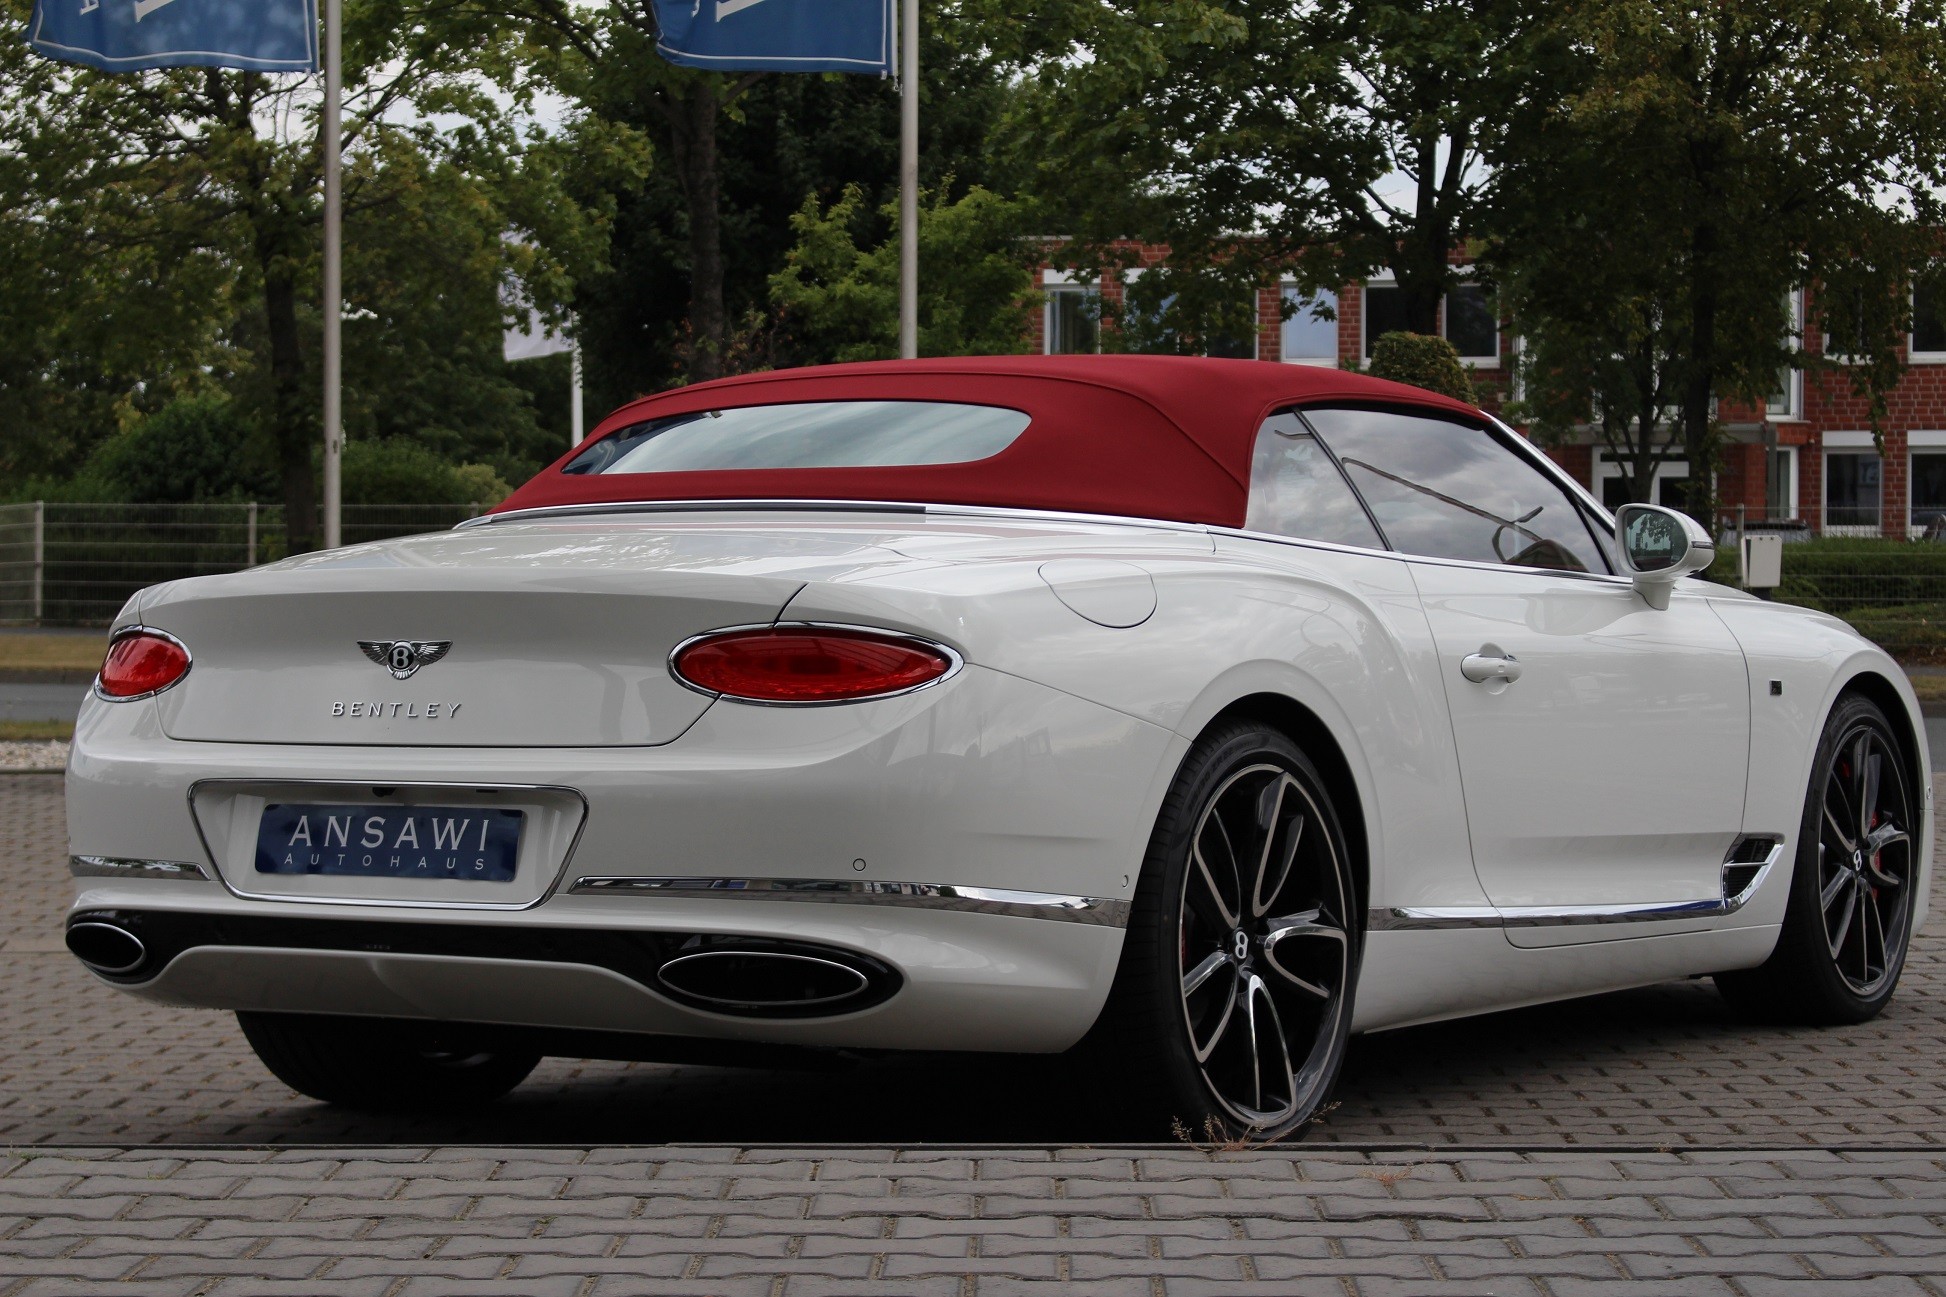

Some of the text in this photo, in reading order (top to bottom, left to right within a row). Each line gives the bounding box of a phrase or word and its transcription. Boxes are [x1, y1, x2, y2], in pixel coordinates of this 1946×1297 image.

[392, 647, 409, 669] B
[331, 701, 462, 719] BENTLEY
[287, 815, 490, 851] ANSAWI
[283, 853, 485, 871] AUTOHAUS
